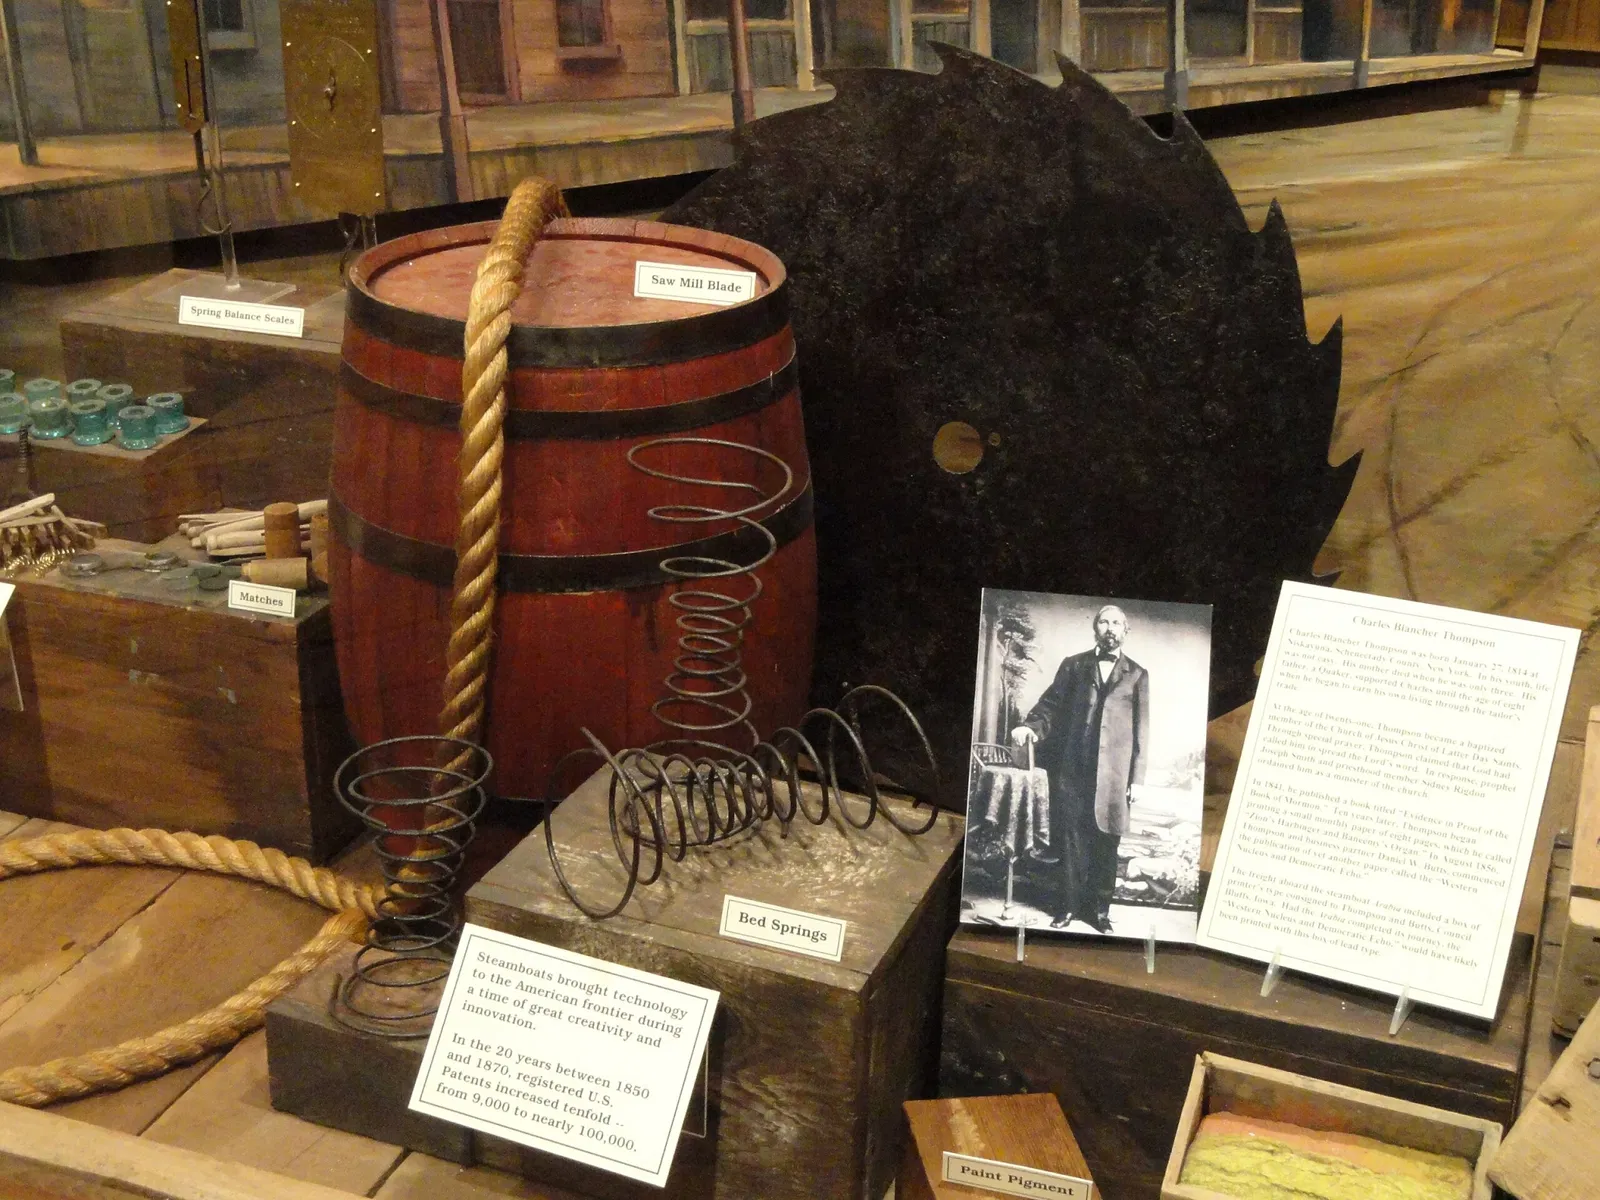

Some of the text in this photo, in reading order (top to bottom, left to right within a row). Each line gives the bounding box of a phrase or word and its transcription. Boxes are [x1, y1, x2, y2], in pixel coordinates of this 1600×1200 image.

[652, 274, 742, 293] Saw Mill Blade
[190, 306, 295, 325] Spring Balance Scales
[240, 592, 284, 607] Matches
[1351, 615, 1496, 648] Charles Blancher Thompson
[738, 912, 828, 944] Bed Springs
[472, 967, 683, 1038] to the American frontier during
[476, 950, 688, 1020] Steamboats brought technology
[461, 999, 536, 1030] innovation.
[466, 985, 662, 1048] a time of great creativity and
[446, 1051, 613, 1107] and 1870, registered U.S.
[451, 1032, 650, 1099] In the 20 years between 1850
[435, 1081, 636, 1152] from 9,000 to nearly 100,000.
[441, 1064, 492, 1089] Patents
[494, 1080, 559, 1110] increased
[562, 1102, 611, 1125] tenfold
[960, 1165, 1074, 1196] Paint Pigment
